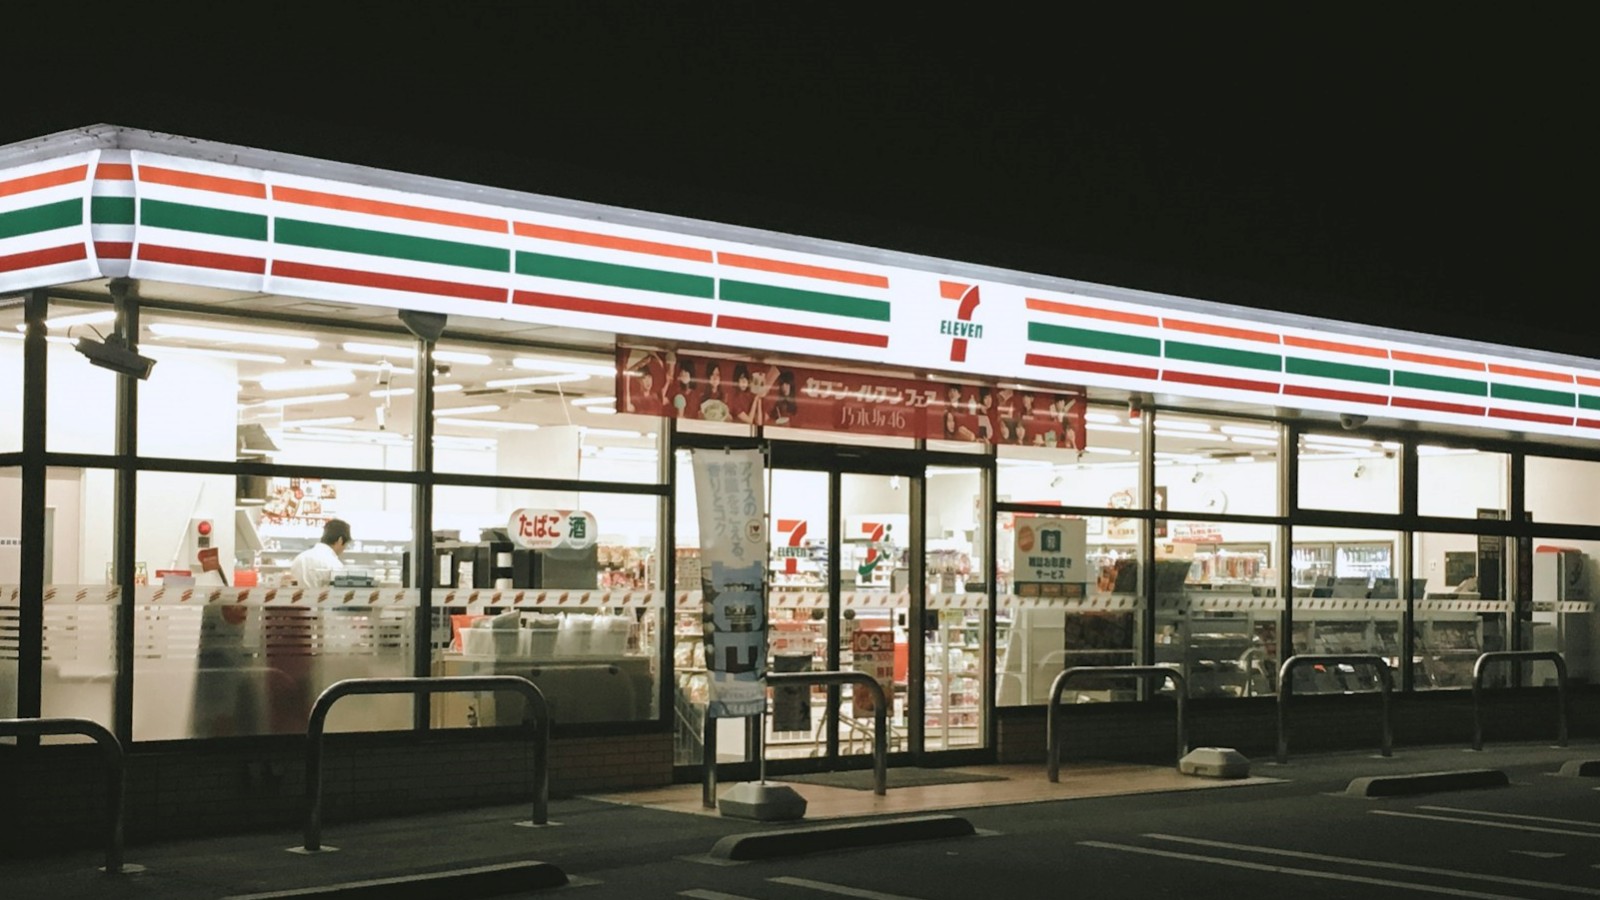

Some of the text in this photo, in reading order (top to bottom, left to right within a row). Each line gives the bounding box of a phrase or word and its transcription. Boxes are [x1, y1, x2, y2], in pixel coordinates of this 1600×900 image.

[939, 280, 980, 362] 7
[519, 514, 586, 539] たばこ 酒
[1036, 570, 1065, 579] サービス
